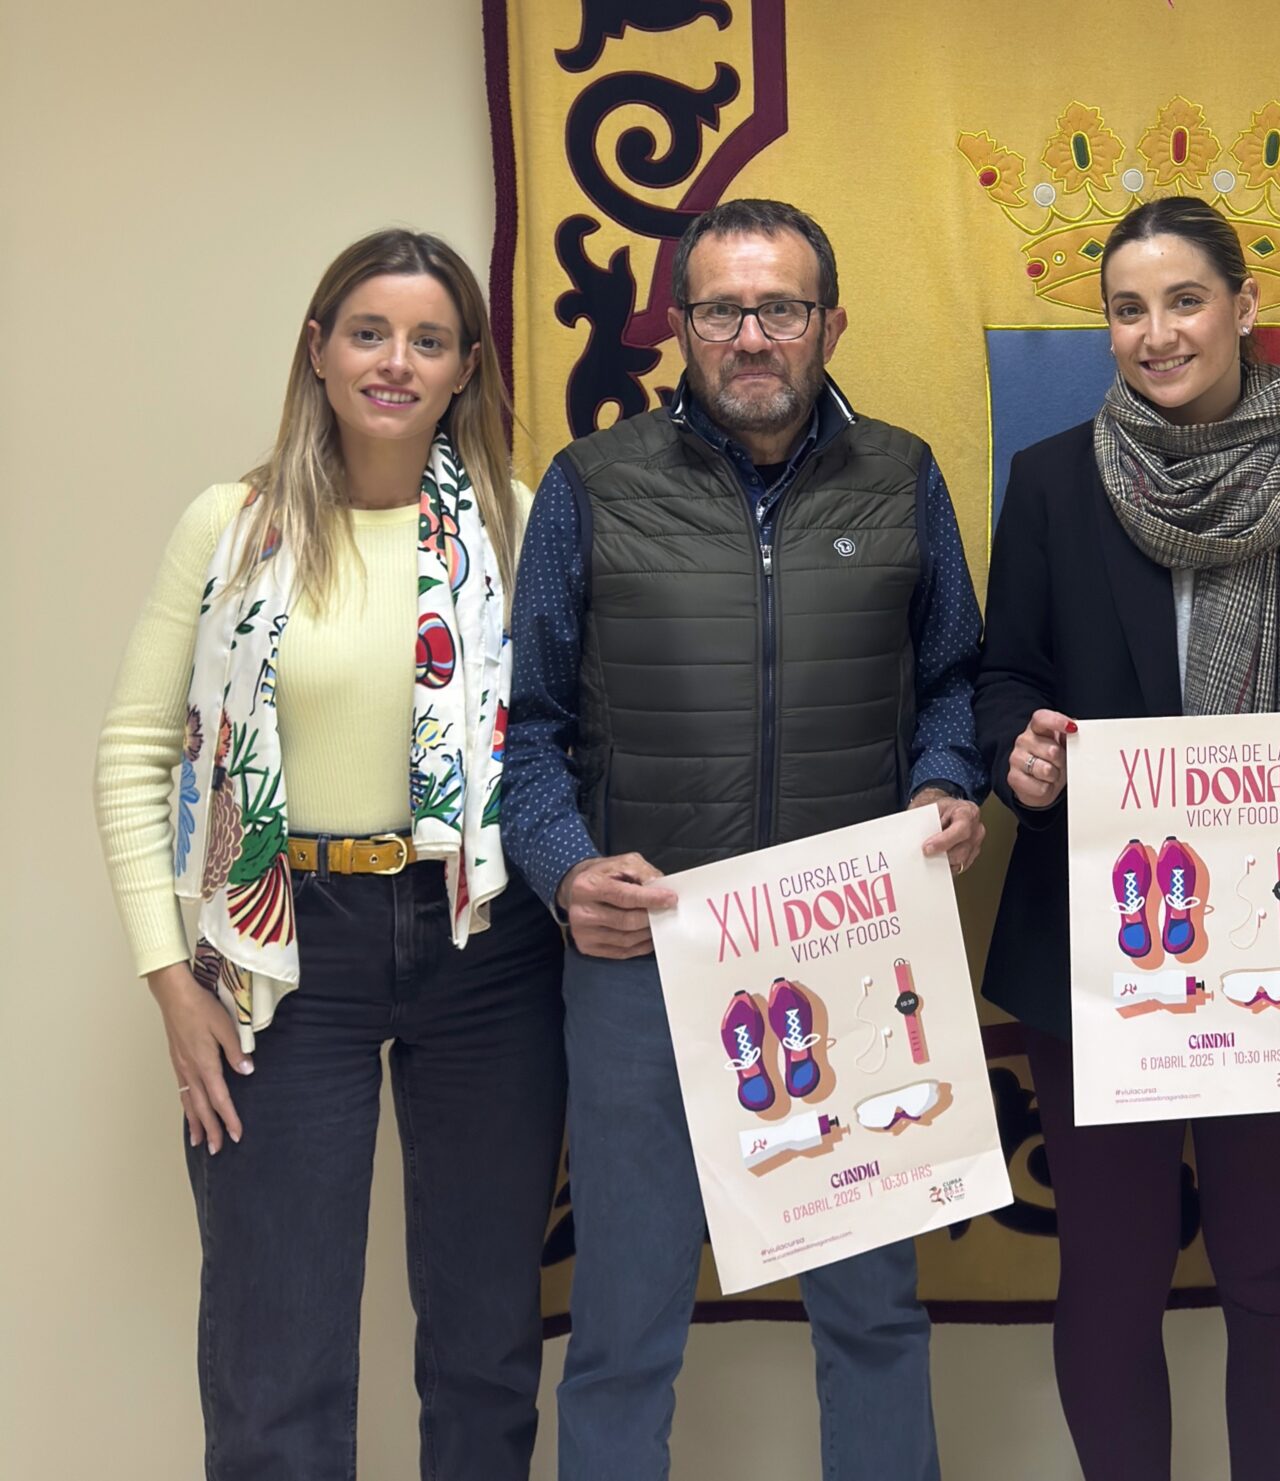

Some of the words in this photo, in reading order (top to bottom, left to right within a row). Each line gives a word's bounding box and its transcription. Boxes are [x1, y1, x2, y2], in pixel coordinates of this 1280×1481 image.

[1186, 745, 1238, 765] CURSA
[1242, 743, 1262, 763] DE
[1119, 747, 1176, 810] XVI
[1186, 808, 1232, 828] VICKY
[779, 865, 837, 898] CURSA
[838, 857, 863, 882] DE
[865, 851, 889, 874] LA
[706, 883, 779, 963] XVI
[783, 873, 897, 941] DONA
[791, 933, 840, 964] VICKY
[846, 916, 901, 949] FOODS
[1141, 1058, 1148, 1071] 6
[1150, 1054, 1187, 1070] D'ABRIL
[1189, 1053, 1214, 1068] 2025
[1234, 1050, 1260, 1065] 10:30
[1188, 1032, 1235, 1050] GANDIA
[783, 1210, 791, 1224] 6
[792, 1197, 833, 1221] D'ABRIL
[833, 1187, 861, 1208] 2025
[880, 1170, 909, 1193] 10:30
[910, 1164, 933, 1183] HRS
[830, 1160, 880, 1189] GANDIA
